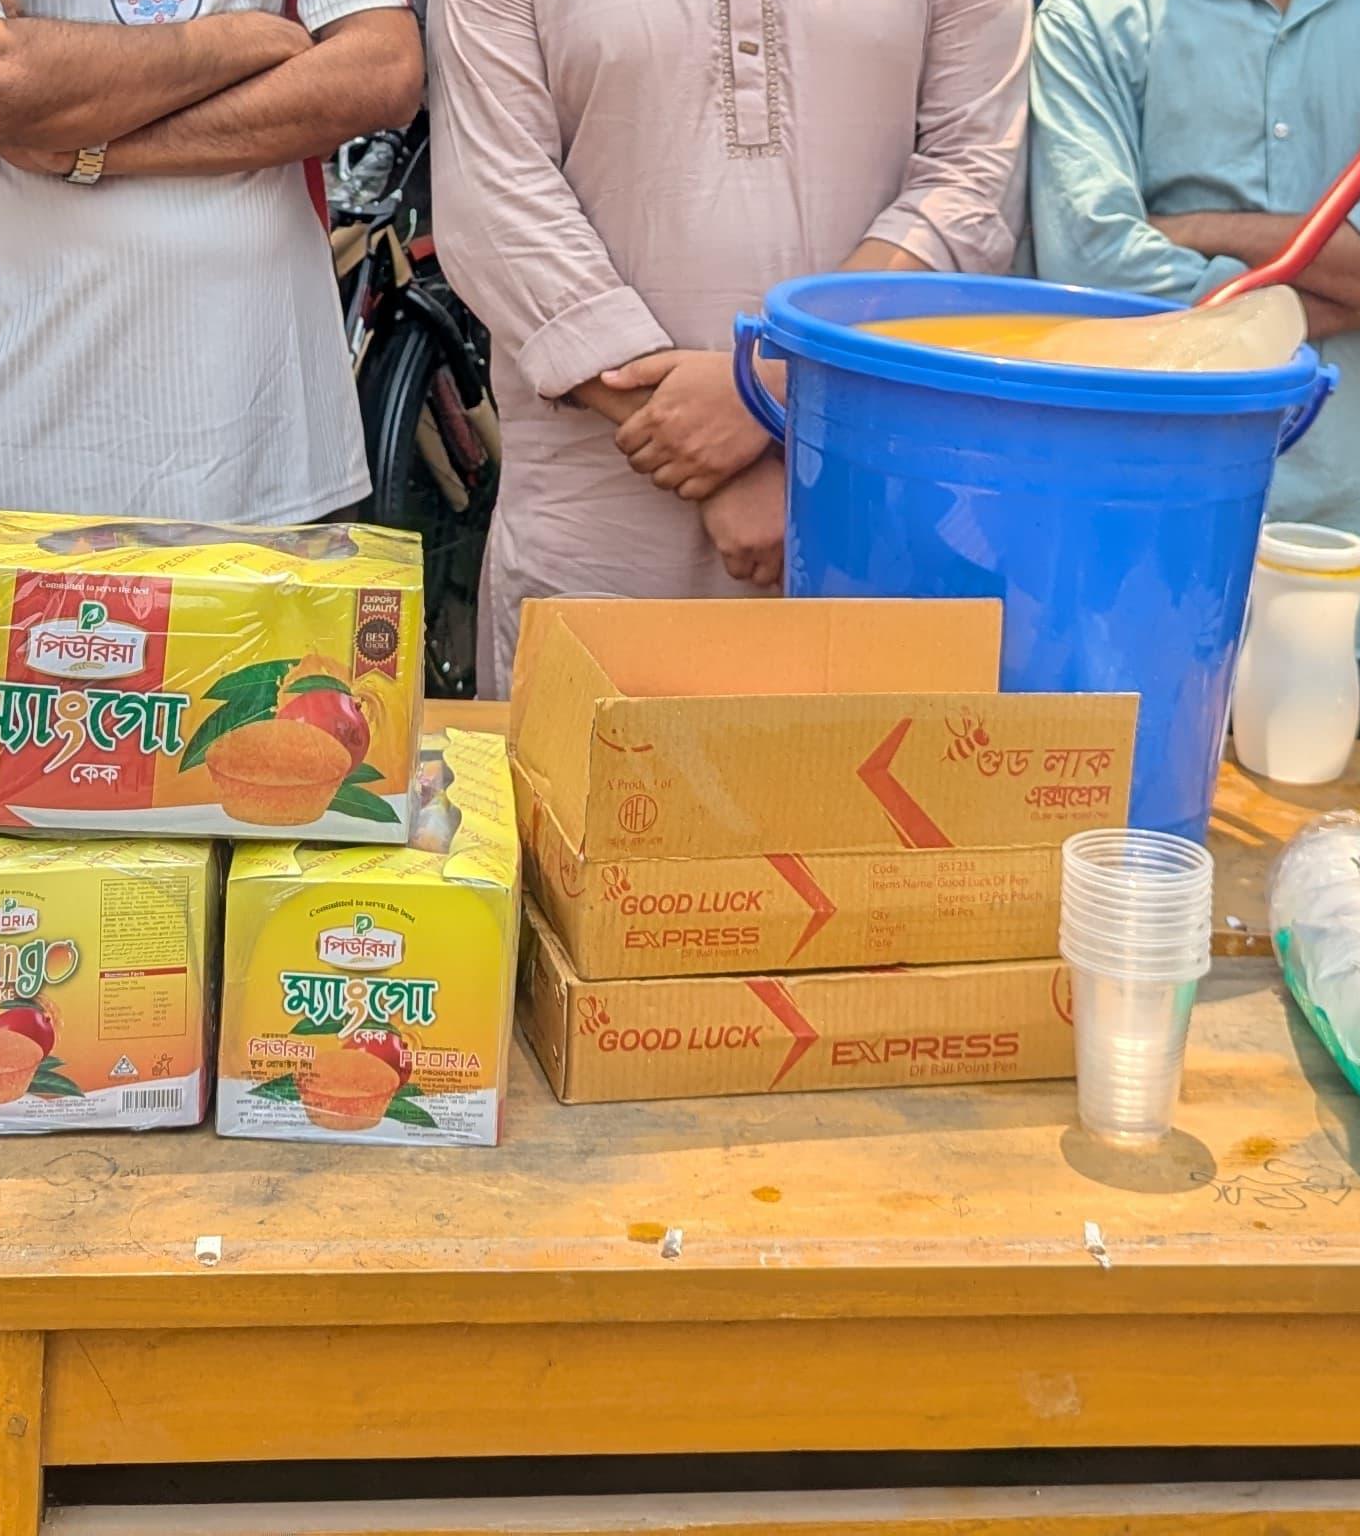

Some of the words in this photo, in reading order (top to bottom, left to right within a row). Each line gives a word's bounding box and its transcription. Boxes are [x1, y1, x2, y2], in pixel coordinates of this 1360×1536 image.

[361, 603, 399, 613] QUALITY
[363, 595, 398, 605] EXPORT
[35, 632, 138, 664] পিউরিয়া
[365, 632, 389, 642] BEST
[70, 763, 121, 785] কেক
[977, 748, 1034, 777] গুড
[1043, 748, 1115, 778] লাক
[903, 878, 933, 889] Name
[620, 894, 693, 915] GOOD
[699, 890, 763, 913] LUCK
[324, 936, 397, 958] পিউরিয়া
[624, 927, 760, 949] EXPRESS
[280, 972, 439, 1037] ম্যাংগো
[354, 1030, 388, 1045] কেক
[597, 1027, 682, 1053] GOOD
[687, 1024, 762, 1049] LUCK
[399, 1050, 481, 1069] PEORIA
[831, 1032, 1019, 1066] EXPRESS
[956, 1061, 996, 1074] Point
[998, 1060, 1018, 1073] Pen
